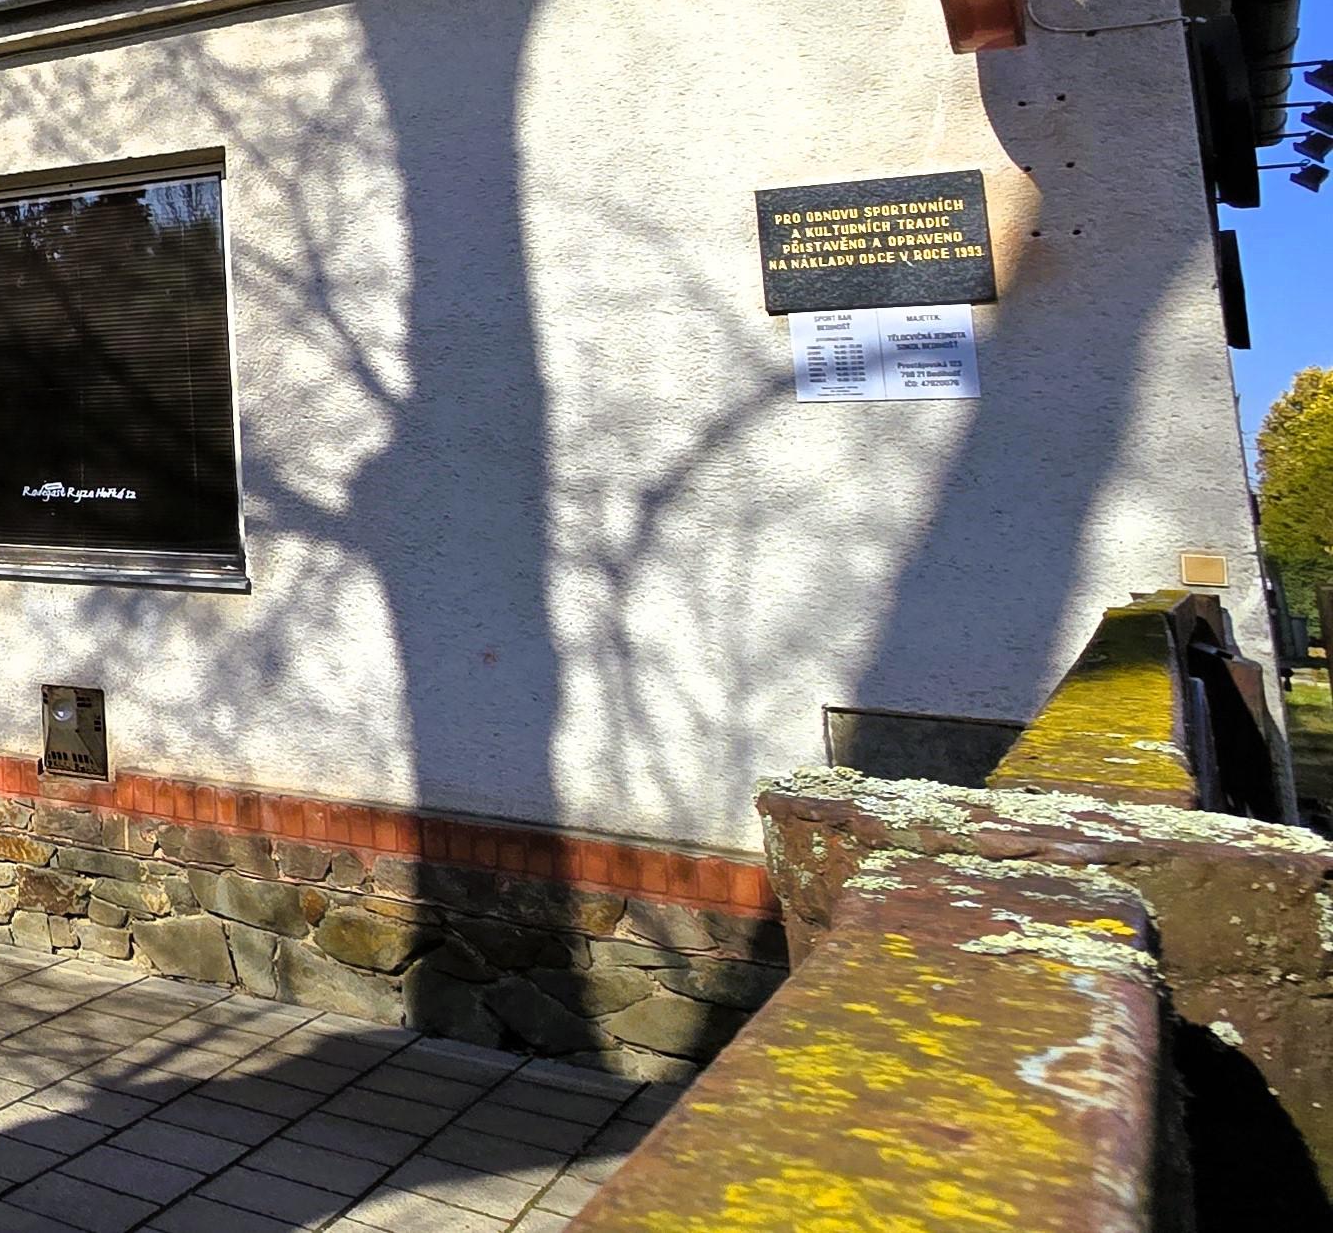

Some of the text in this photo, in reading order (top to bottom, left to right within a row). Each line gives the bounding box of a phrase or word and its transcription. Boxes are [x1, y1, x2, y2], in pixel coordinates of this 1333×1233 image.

[774, 196, 964, 225] PRO OBNOVU SPORTOVNÍCH
[791, 215, 950, 239] A KULTURNÍCH TRADIC
[782, 231, 963, 254] PŘISTAVĚNO A OPRAVENO
[769, 259, 788, 271] NA
[790, 254, 854, 269] NÁKLADY
[859, 251, 895, 265] OBCE
[899, 250, 909, 262] V
[913, 247, 950, 261] ROCE
